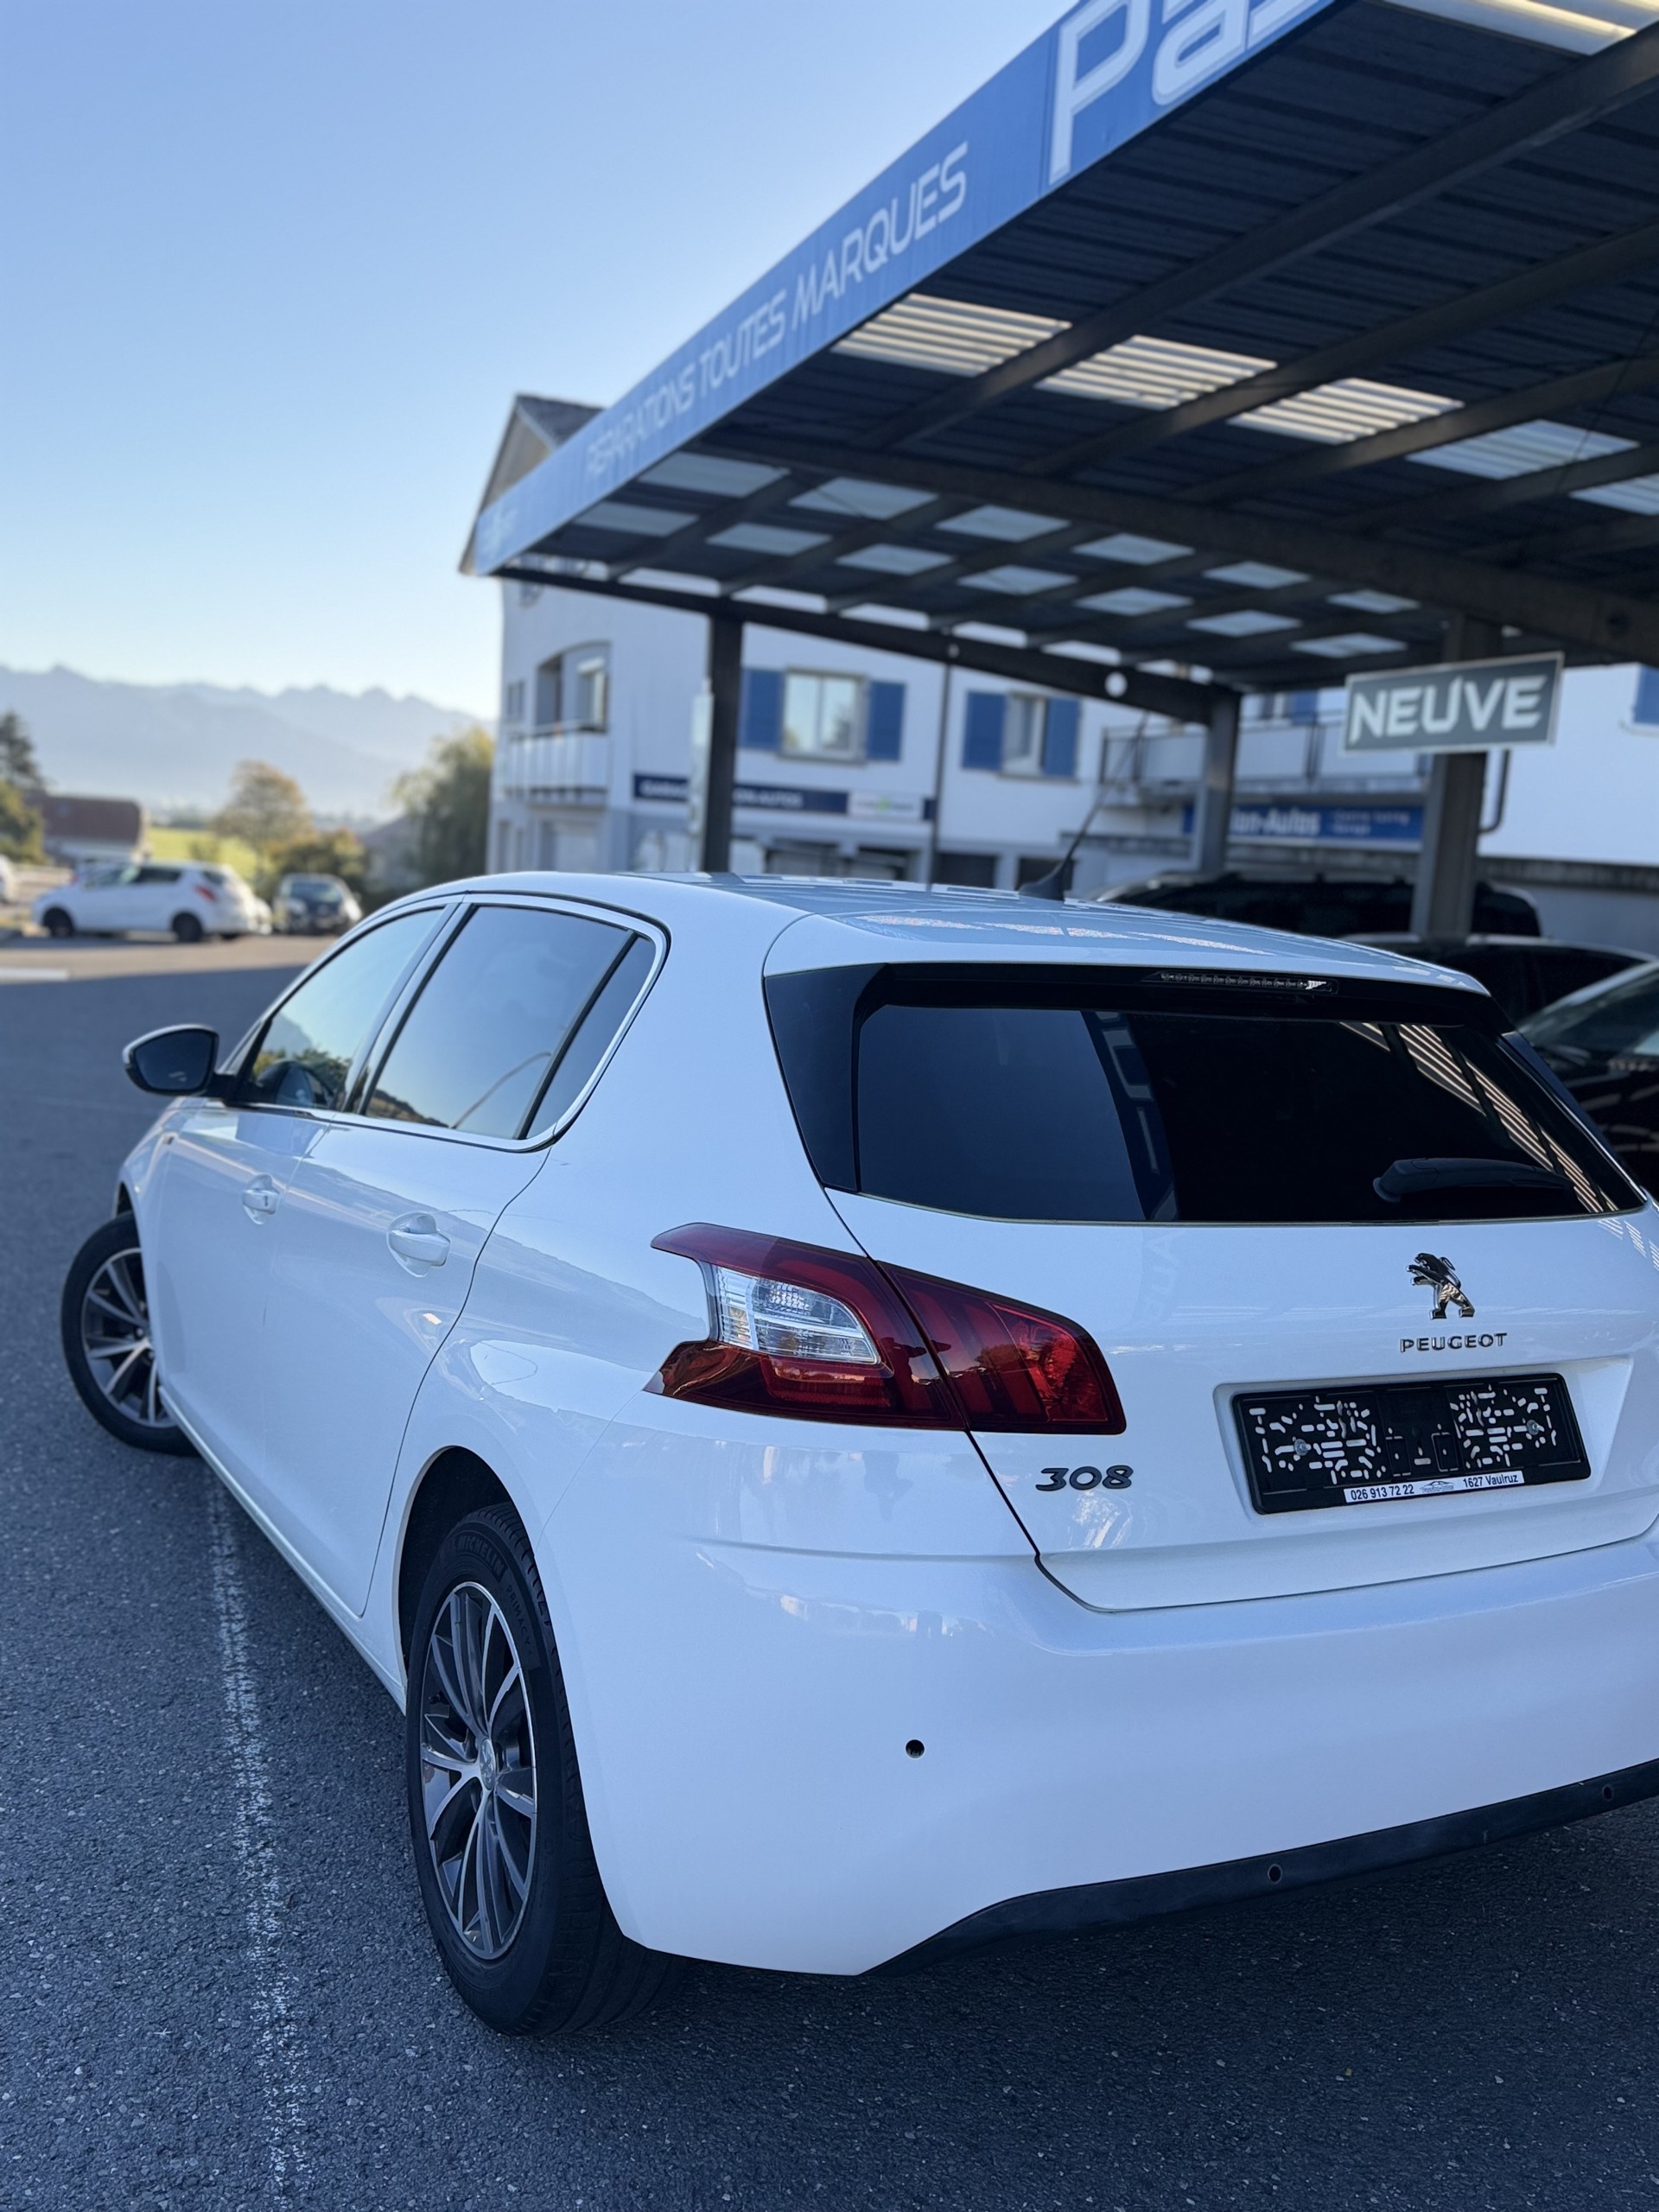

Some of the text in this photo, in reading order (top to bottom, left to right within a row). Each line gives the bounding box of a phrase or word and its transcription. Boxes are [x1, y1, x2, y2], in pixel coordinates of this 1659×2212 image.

[1048, 0, 1332, 186] Pa
[698, 289, 788, 397] TOUTES
[791, 140, 969, 331] MARQUES
[1348, 676, 1547, 745] NEUVE
[1400, 1332, 1508, 1352] PEUGEOT
[1035, 1465, 1134, 1491] 308
[1351, 1489, 1368, 1501] 026
[1370, 1487, 1388, 1498] 913
[1389, 1485, 1402, 1497] 72
[1402, 1484, 1415, 1495] 22
[1463, 1476, 1483, 1488] 1627
[1485, 1473, 1519, 1485] Vaulruz
[505, 1584, 531, 1646] PRIMACY
